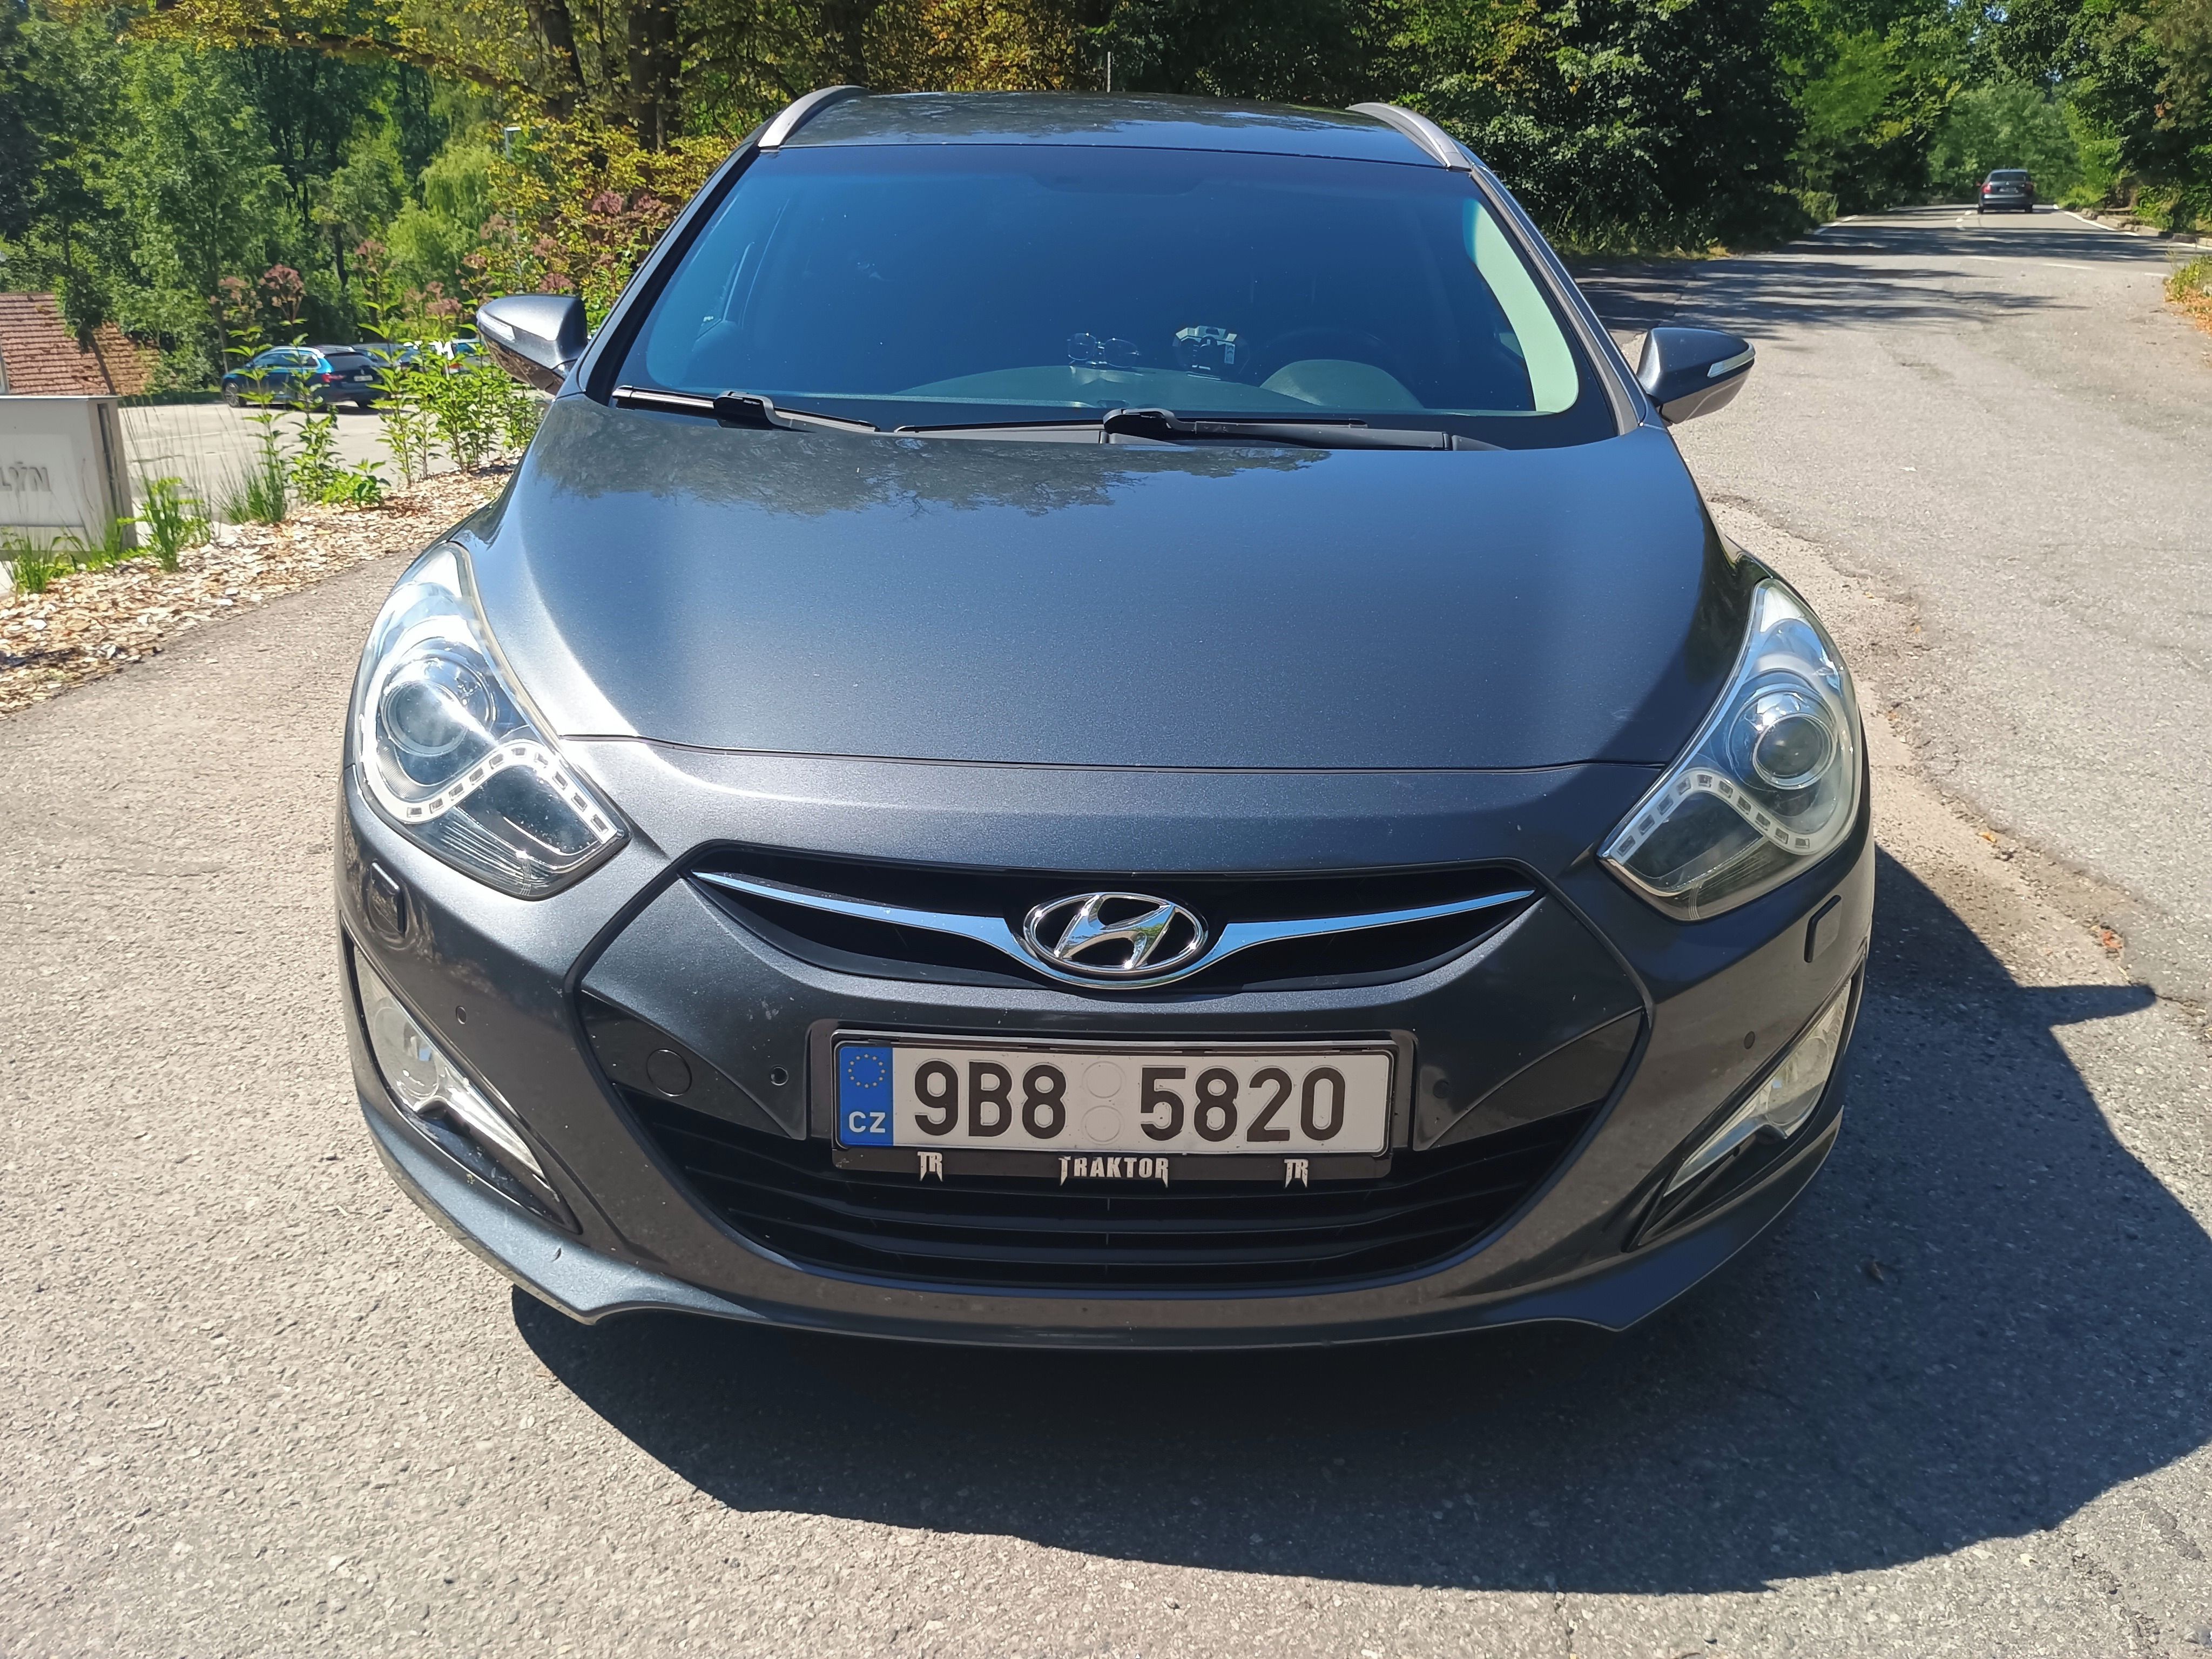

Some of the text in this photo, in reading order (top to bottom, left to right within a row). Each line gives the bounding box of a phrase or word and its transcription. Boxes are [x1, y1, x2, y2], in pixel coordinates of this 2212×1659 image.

[914, 1060, 1346, 1142] 9B8 5820
[848, 1111, 886, 1133] CZ
[917, 1151, 943, 1182] TR
[1058, 1156, 1169, 1188] TRAKTOR
[1284, 1158, 1309, 1189] TR
